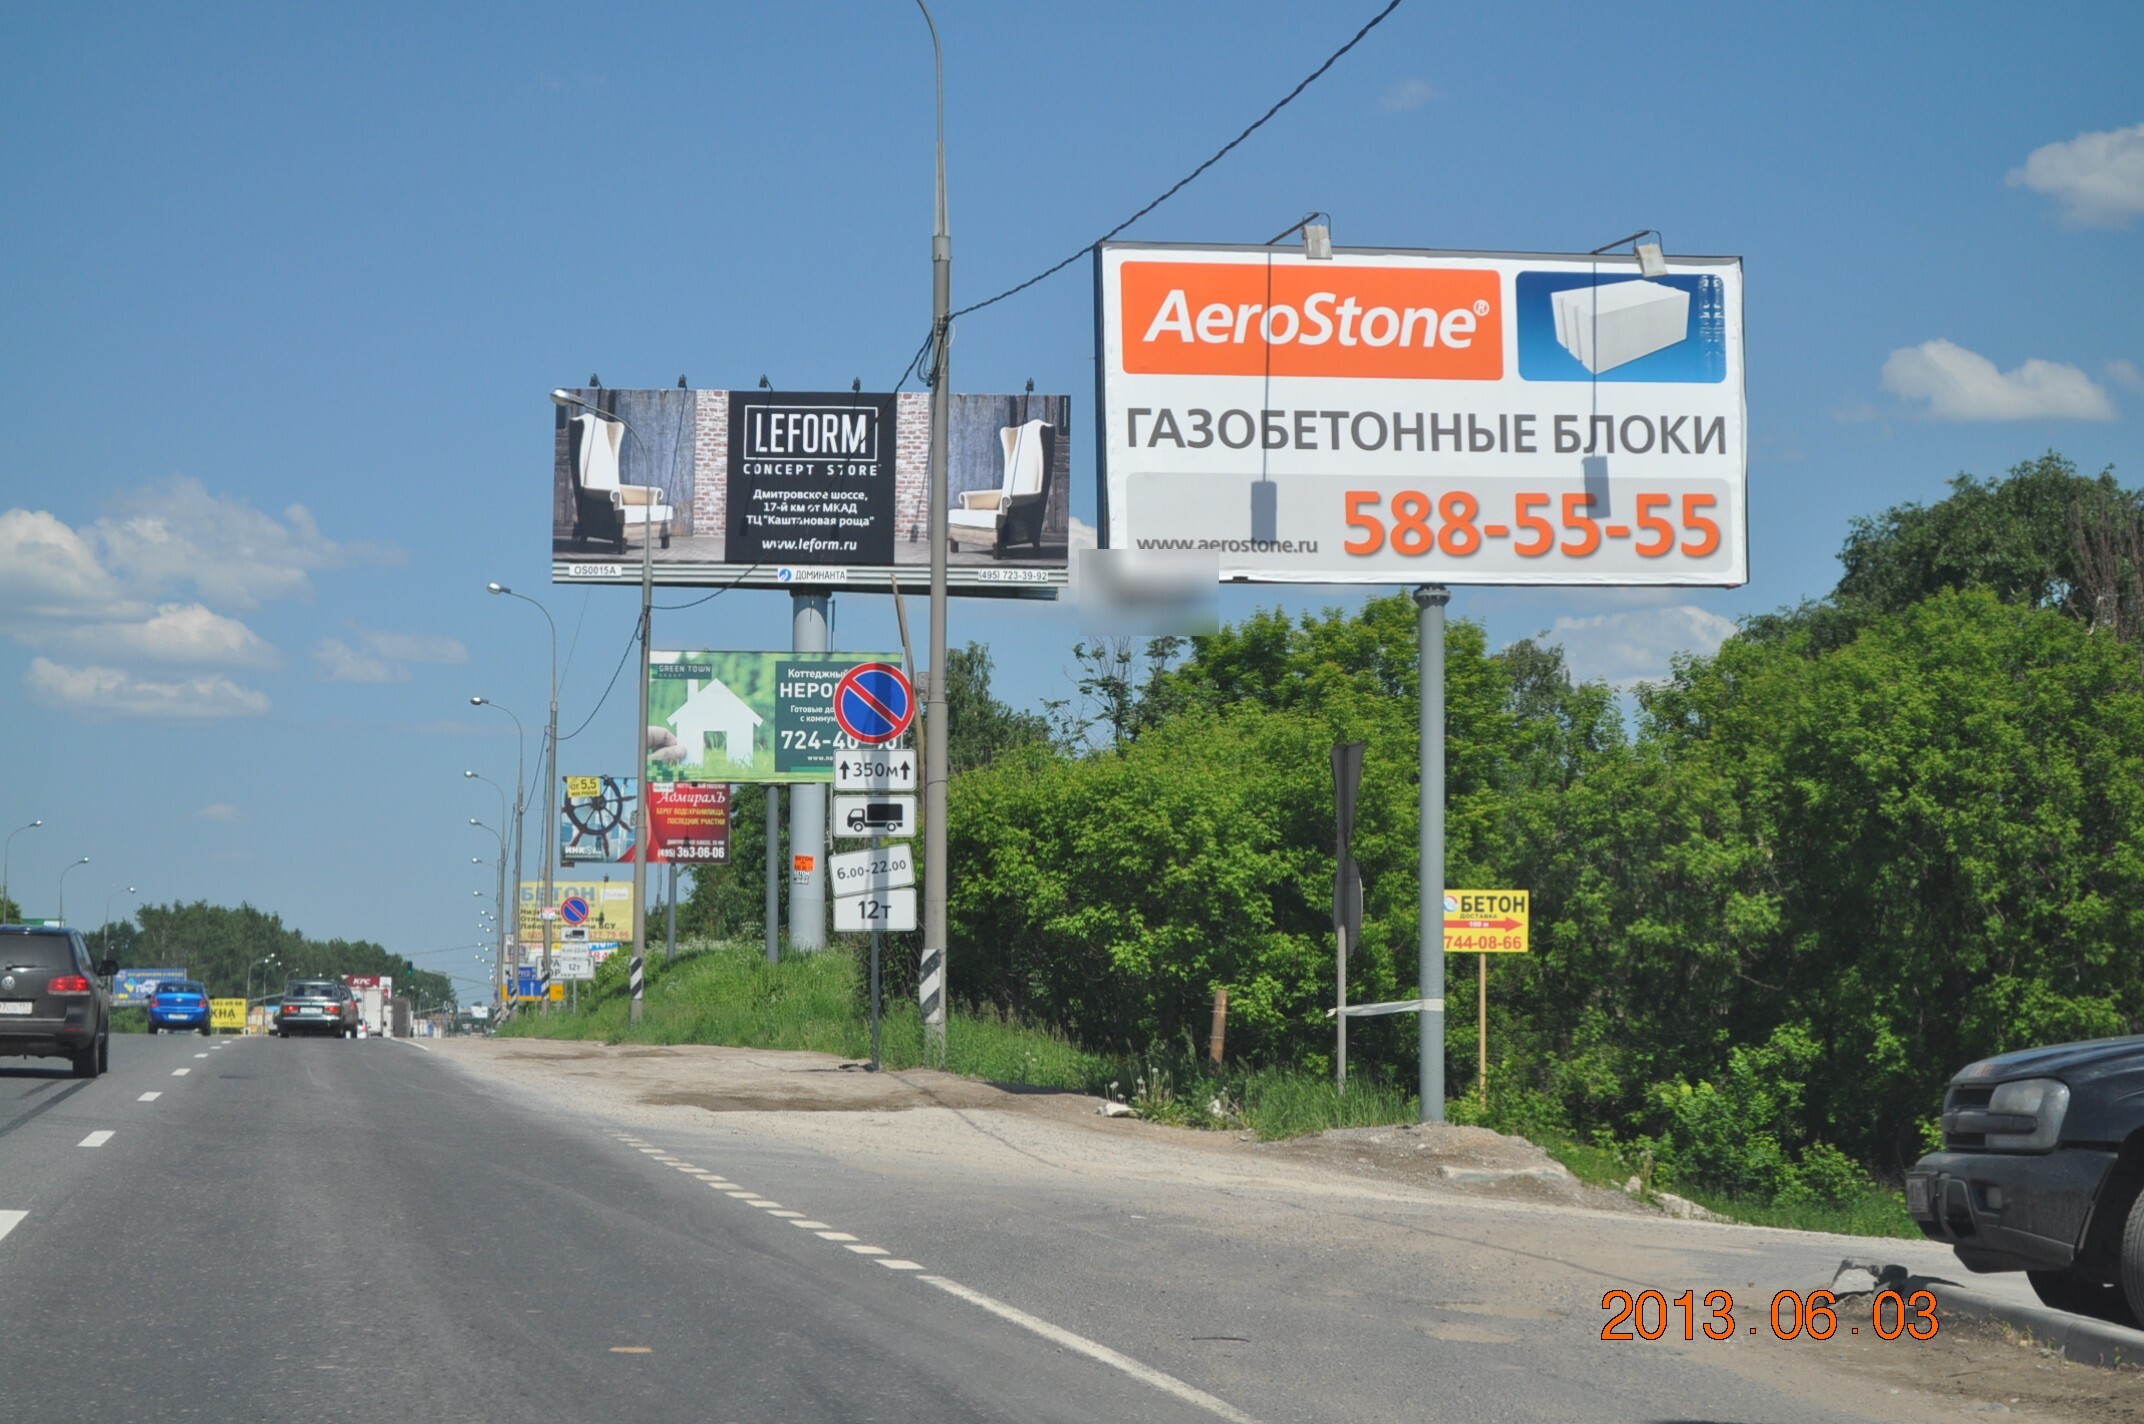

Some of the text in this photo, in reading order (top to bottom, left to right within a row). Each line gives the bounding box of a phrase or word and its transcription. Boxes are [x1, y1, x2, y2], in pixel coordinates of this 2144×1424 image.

[755, 412, 867, 454] LEFORM
[1127, 407, 1728, 456] ГАЗОБЕТОННЫЕ БЛОКИ
[743, 463, 878, 476] CONCEPT STORE
[752, 489, 869, 501] Дмитровское шоссе,
[763, 502, 858, 514] 17-й км от МКАД
[746, 515, 763, 526] ТЦ
[1343, 488, 1721, 558] 588-55-55
[761, 538, 858, 553] www.leform.ru
[795, 570, 846, 580] ДОМИНАНТА
[979, 571, 1001, 580] (495)
[659, 665, 711, 673] GREEN TOWN
[779, 682, 837, 698] НЕРО
[790, 705, 835, 714] Готовые до
[806, 716, 837, 724] коммун
[580, 778, 597, 790] 5,5
[657, 846, 725, 858] (495) 363-06-06
[836, 859, 907, 880] 6.00-22.00
[1460, 895, 1526, 913] БЕТОН
[1444, 935, 1522, 950] 744-08-66
[210, 1008, 236, 1019] КНА
